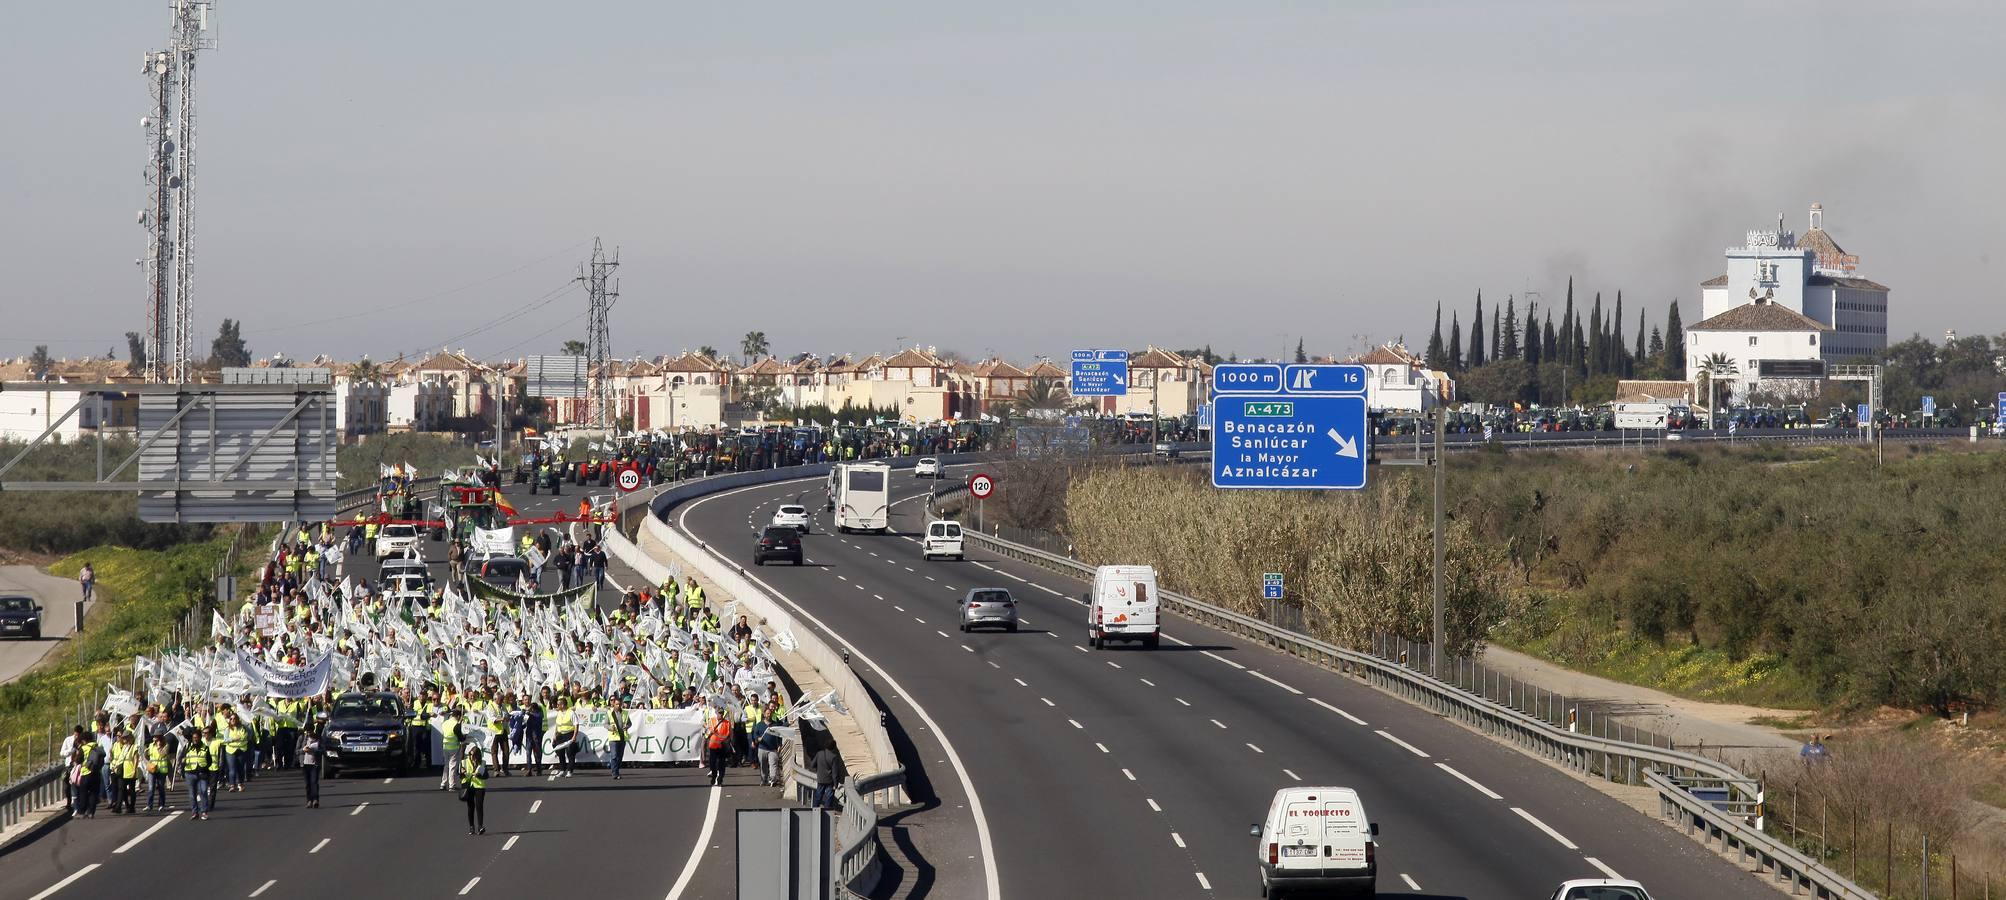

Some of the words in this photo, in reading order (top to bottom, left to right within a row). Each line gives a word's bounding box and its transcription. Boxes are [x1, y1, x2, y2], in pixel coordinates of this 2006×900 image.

[1221, 372, 1258, 383] 1000
[1263, 374, 1274, 383] m
[1343, 372, 1358, 383] 16
[1247, 404, 1291, 414] A-473
[1224, 420, 1315, 433] Benacazón
[1232, 436, 1308, 449] Sanlúcar
[1241, 453, 1251, 462] la
[1258, 453, 1299, 465] Mayor
[1221, 464, 1318, 477] Aznalcázar
[621, 475, 637, 484] 120
[974, 482, 989, 491] 120
[263, 669, 318, 681] ARROCEROS
[285, 677, 316, 690] MAYOR
[627, 735, 691, 755] VIVO!
[1303, 809, 1350, 817] TOQUECITO
